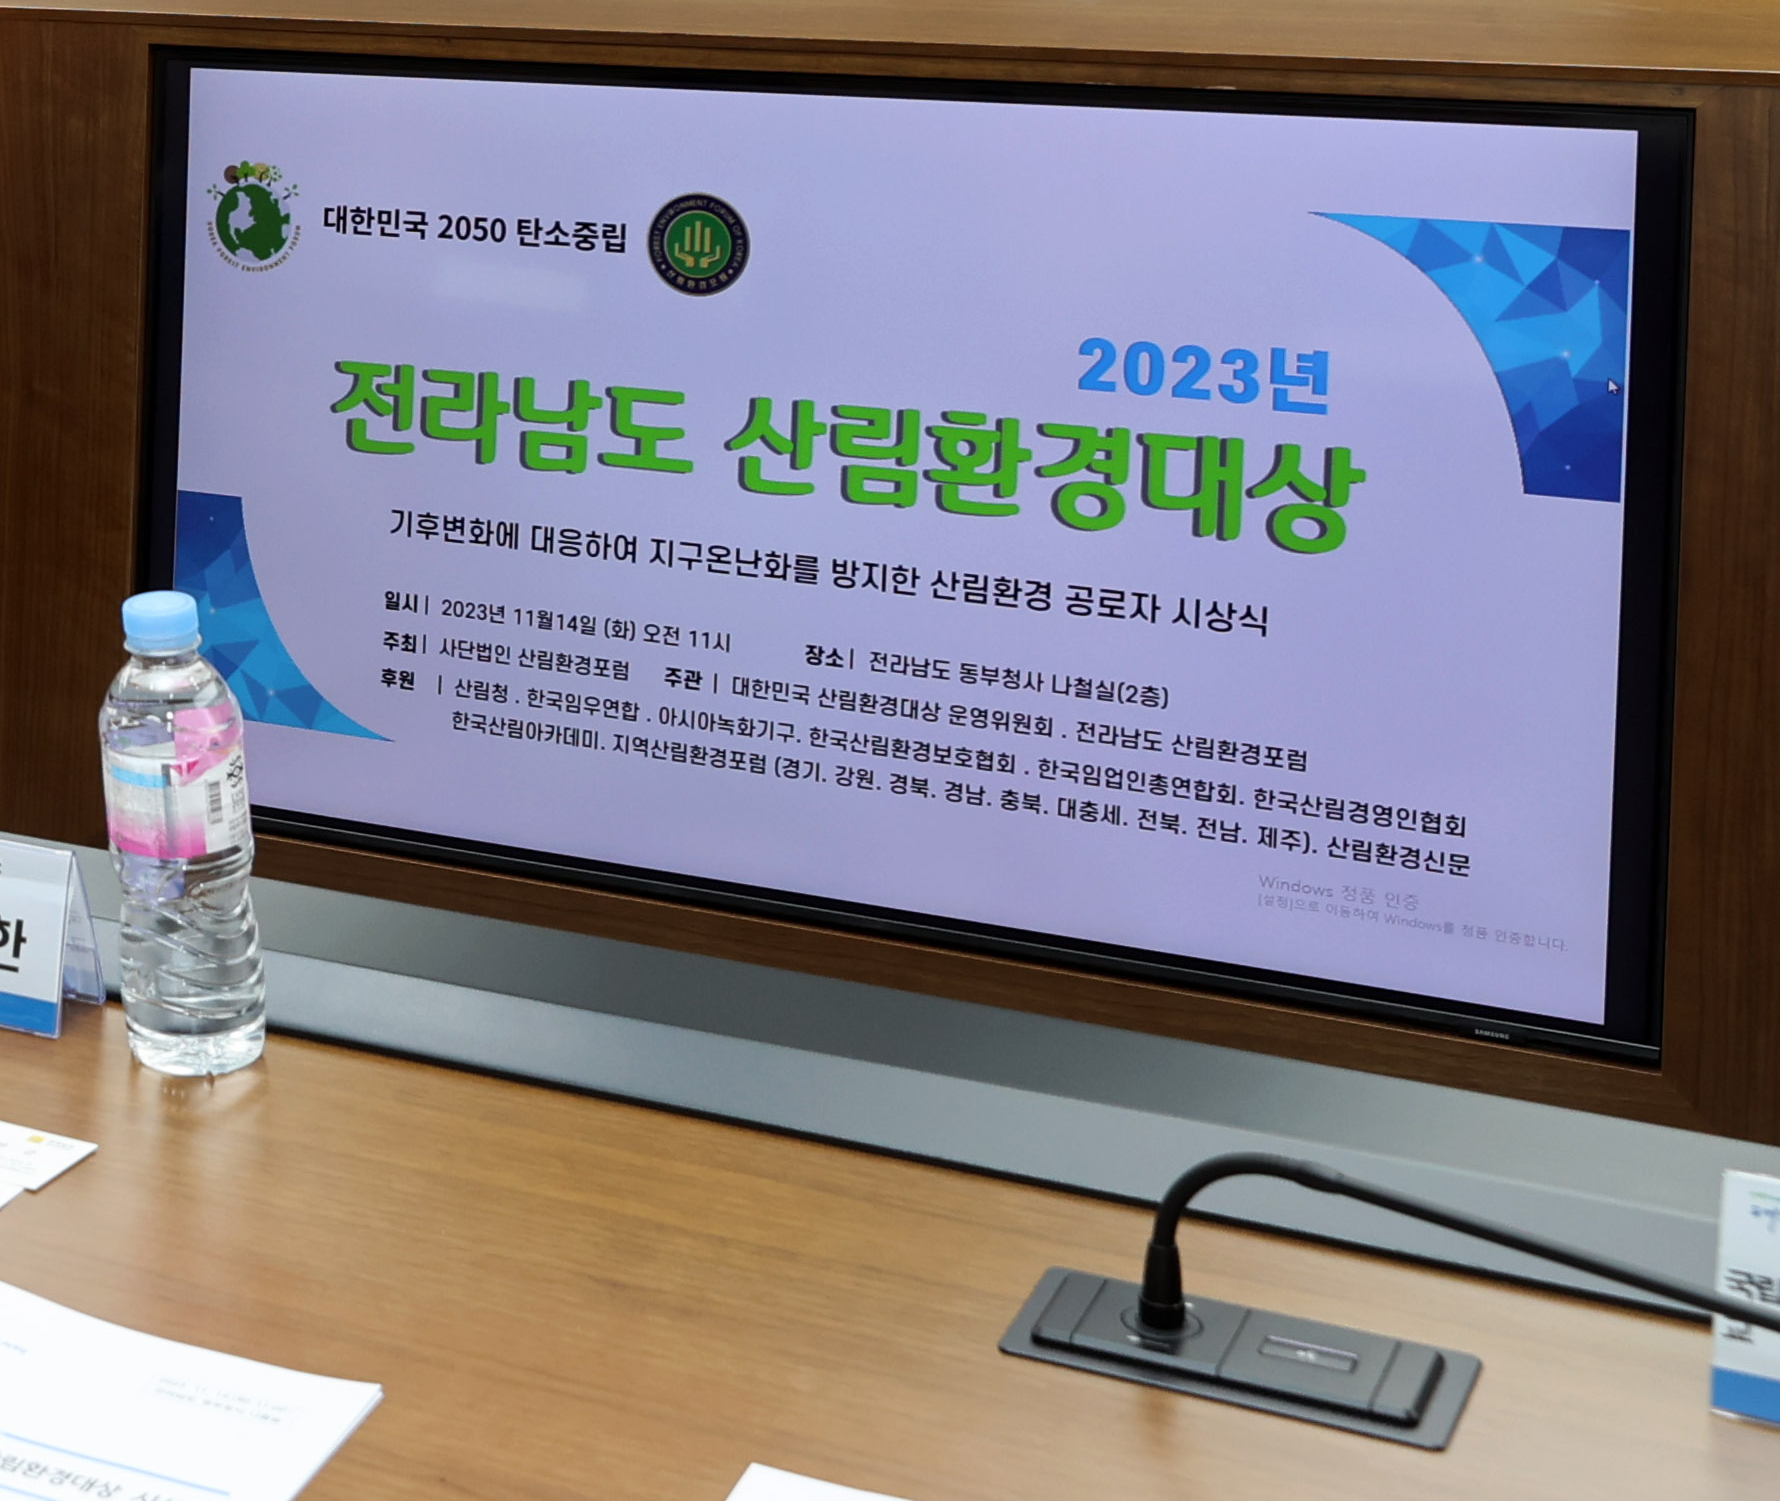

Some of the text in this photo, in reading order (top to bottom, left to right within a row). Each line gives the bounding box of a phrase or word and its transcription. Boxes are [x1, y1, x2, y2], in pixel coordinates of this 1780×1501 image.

[322, 204, 626, 254] 대한민국 2050 탄소중립
[1076, 332, 1331, 416] 2023년
[328, 357, 1369, 561] 전라남도 산림환경대상
[389, 507, 1268, 638] 기후변화에 대응하여 지구온난화를 방지한 산림환경 공로자 시상식
[439, 637, 511, 666] 사단법인
[517, 646, 629, 682] 산림환경포럼
[441, 597, 506, 625] 2023년
[513, 606, 596, 637] 11월14일
[603, 616, 636, 643] (화)
[642, 622, 680, 648] 오전
[688, 628, 730, 653] 11시
[869, 650, 951, 682] 전라남도
[959, 661, 1045, 694] 동부청사
[1051, 672, 1169, 710] 나철실(2층)
[380, 666, 415, 691] 후원
[454, 676, 508, 705] 산림청
[526, 687, 641, 723] 한국임우연합
[808, 725, 1015, 776] 한국산림환경보호협회
[1253, 786, 1466, 839] 한국산림경영인협회
[731, 675, 811, 706] 대한민국
[817, 686, 942, 724] 산림환경대상
[947, 703, 1053, 739] 운영위원회
[1075, 720, 1163, 754] 전라남도
[1170, 732, 1307, 773] 산림환경포럼
[612, 732, 766, 776] 지역산림환경포럼
[1326, 834, 1471, 879] 산림환경신문
[1257, 873, 1336, 900] Windows
[1340, 884, 1377, 908] 정품
[1474, 1028, 1510, 1041] SAMSUNG
